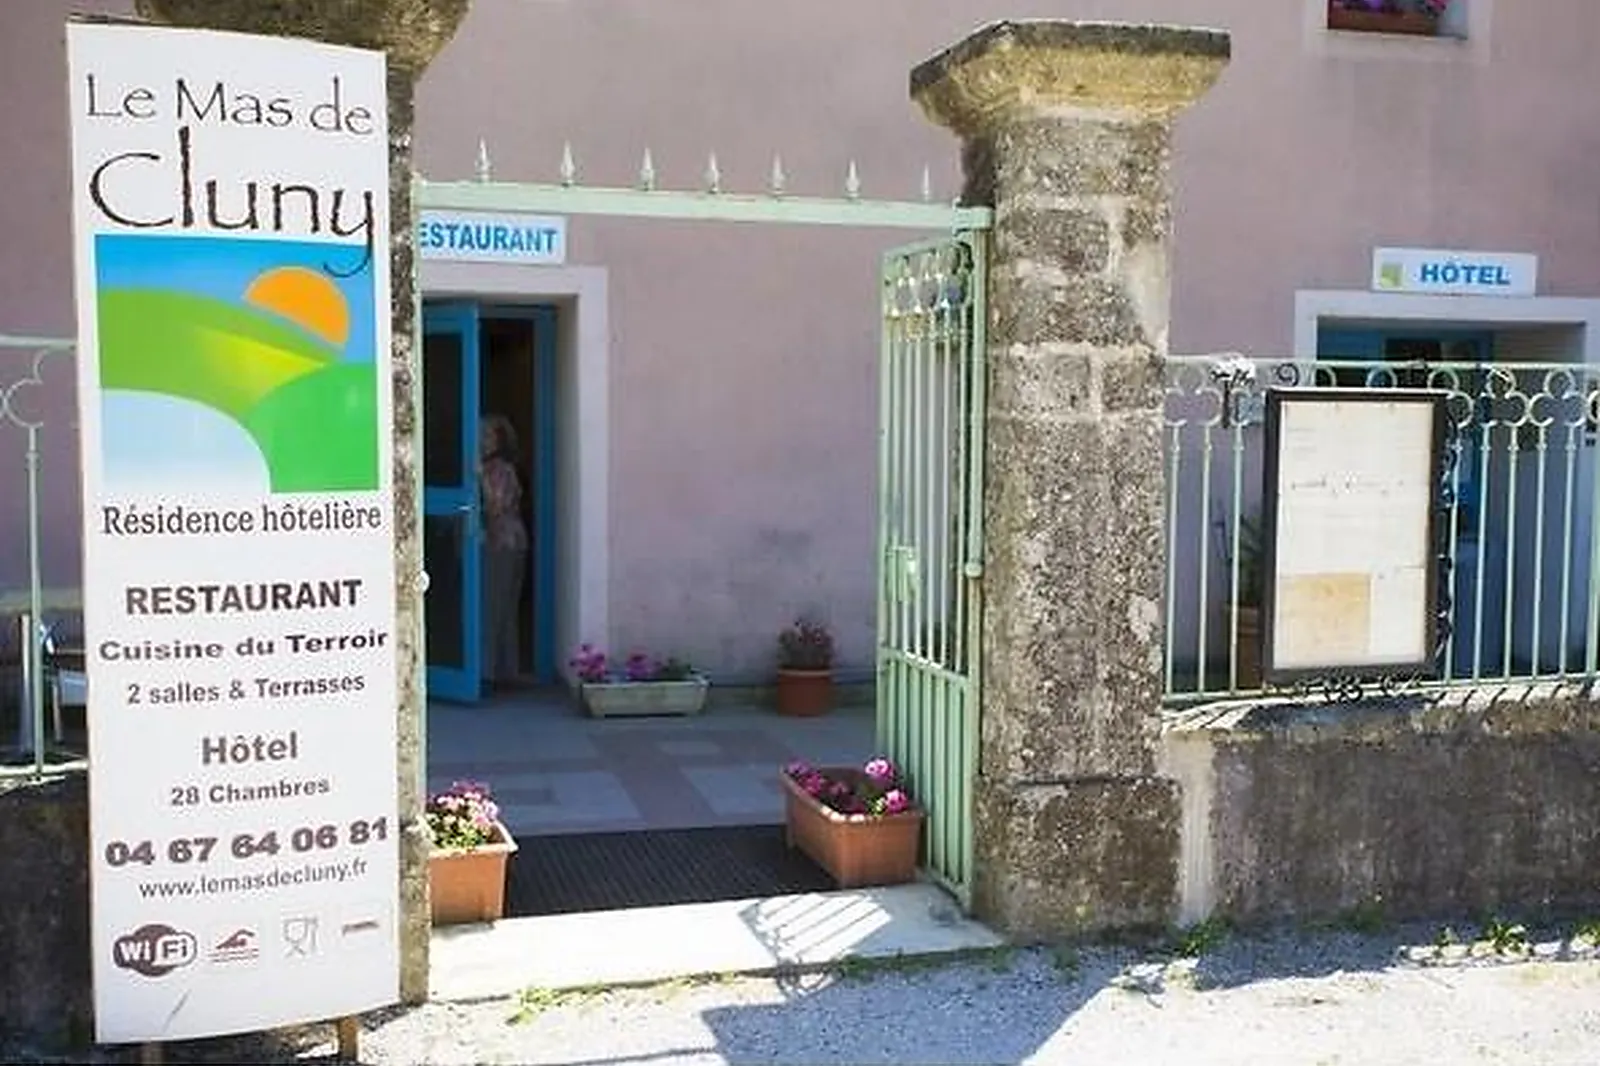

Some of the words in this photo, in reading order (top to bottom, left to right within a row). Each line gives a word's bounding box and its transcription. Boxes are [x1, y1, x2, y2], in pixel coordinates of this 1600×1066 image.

[86, 73, 156, 119] Le
[176, 78, 293, 127] Mas
[309, 76, 374, 135] de
[89, 125, 374, 278] Cluny
[420, 222, 557, 252] ESTAURANT
[1420, 257, 1511, 285] HÔTEL
[102, 504, 255, 535] Résidence
[263, 501, 383, 532] hôtelière
[126, 579, 362, 615] RESTAURANT
[99, 639, 224, 661] Cuisine
[235, 636, 275, 657] du
[285, 628, 388, 654] Terroir
[127, 684, 141, 705] 2
[150, 680, 220, 705] salles
[228, 677, 246, 700] &
[254, 673, 365, 698] Terrasses
[201, 731, 299, 766] Hôtel
[171, 786, 200, 807] 28
[209, 778, 331, 805] Chambres
[104, 841, 156, 867] 04
[167, 836, 218, 863] 67
[231, 831, 281, 860] 64
[291, 824, 339, 852] 06
[349, 816, 390, 845] 81
[138, 858, 368, 899] www.lemasdecluny.fr
